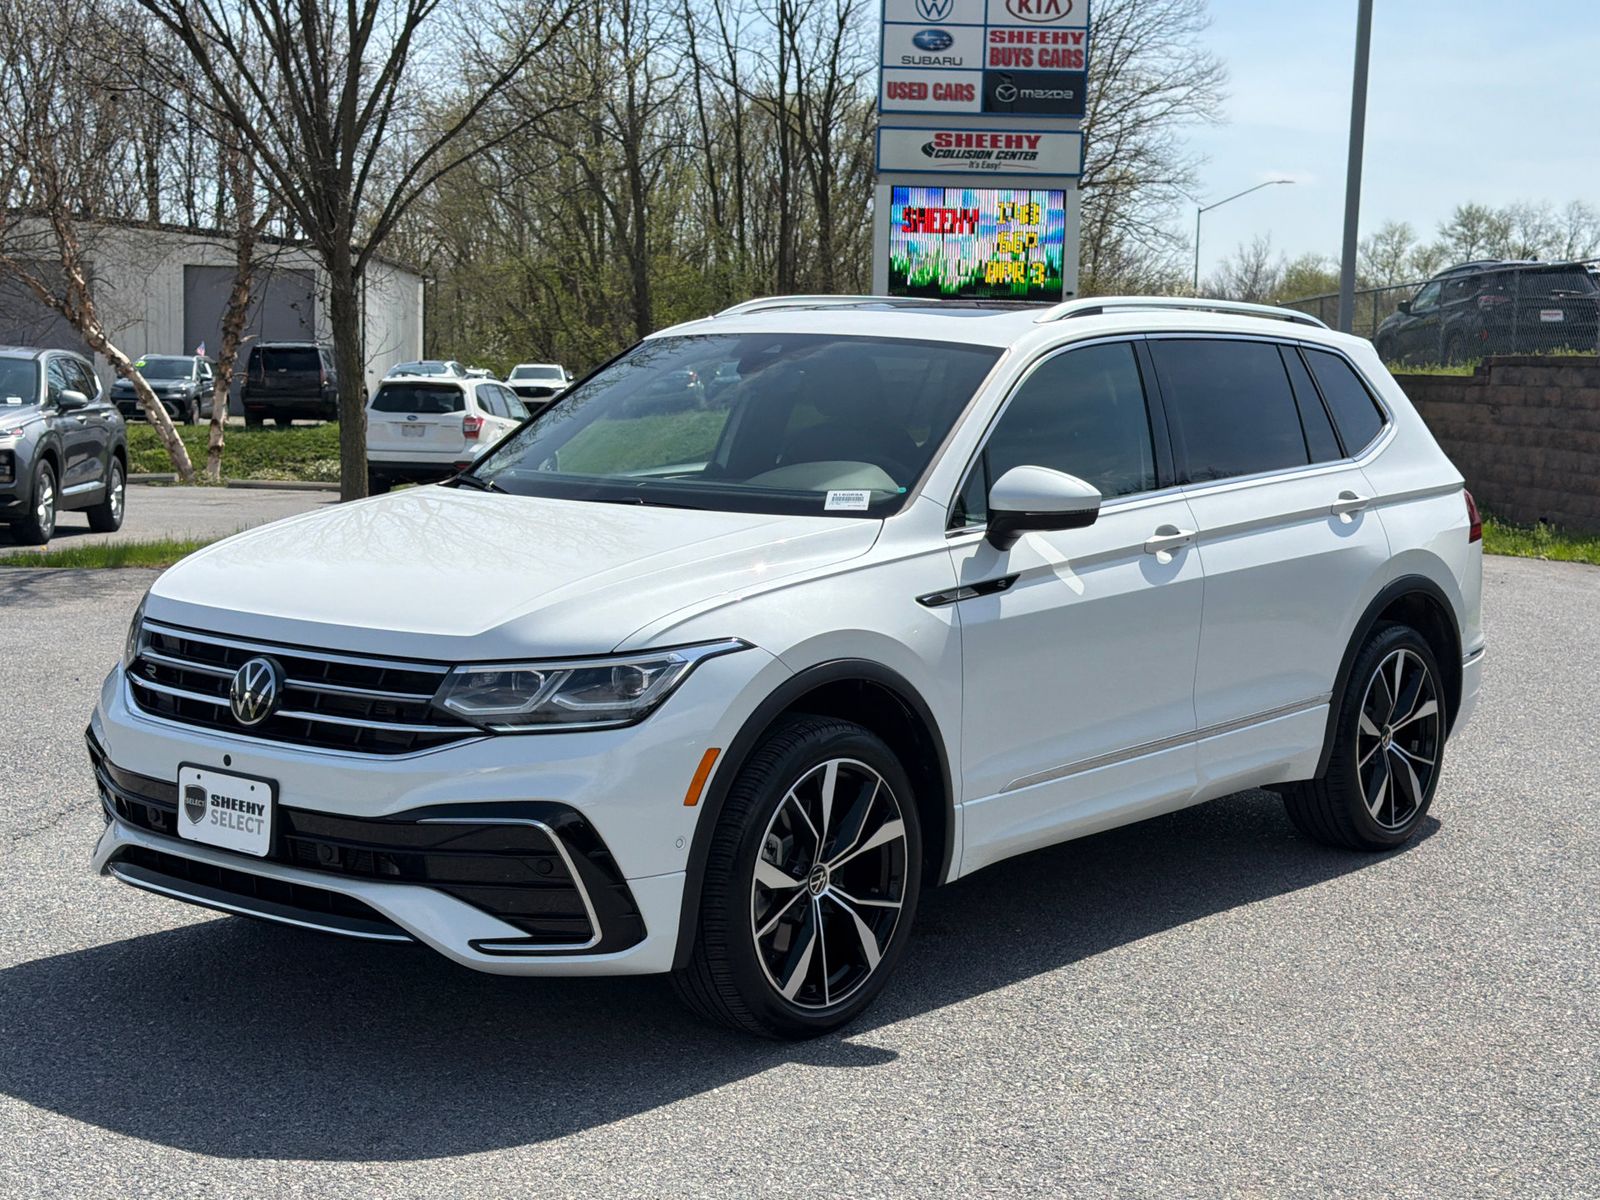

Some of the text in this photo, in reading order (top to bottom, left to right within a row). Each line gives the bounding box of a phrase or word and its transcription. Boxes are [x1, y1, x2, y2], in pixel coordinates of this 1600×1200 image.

[989, 30, 1085, 45] SHEEHY
[901, 55, 963, 66] SUBARU
[989, 47, 1084, 69] BUYS CARS
[887, 81, 975, 102] USED CARS
[934, 132, 1042, 150] SHEEHY
[934, 149, 1039, 161] COLLISION CENTER
[968, 161, 1002, 171] It's Easy!
[902, 207, 979, 234] SHEEHY
[211, 794, 265, 817] SHEEHY
[211, 809, 264, 835] SELECT
